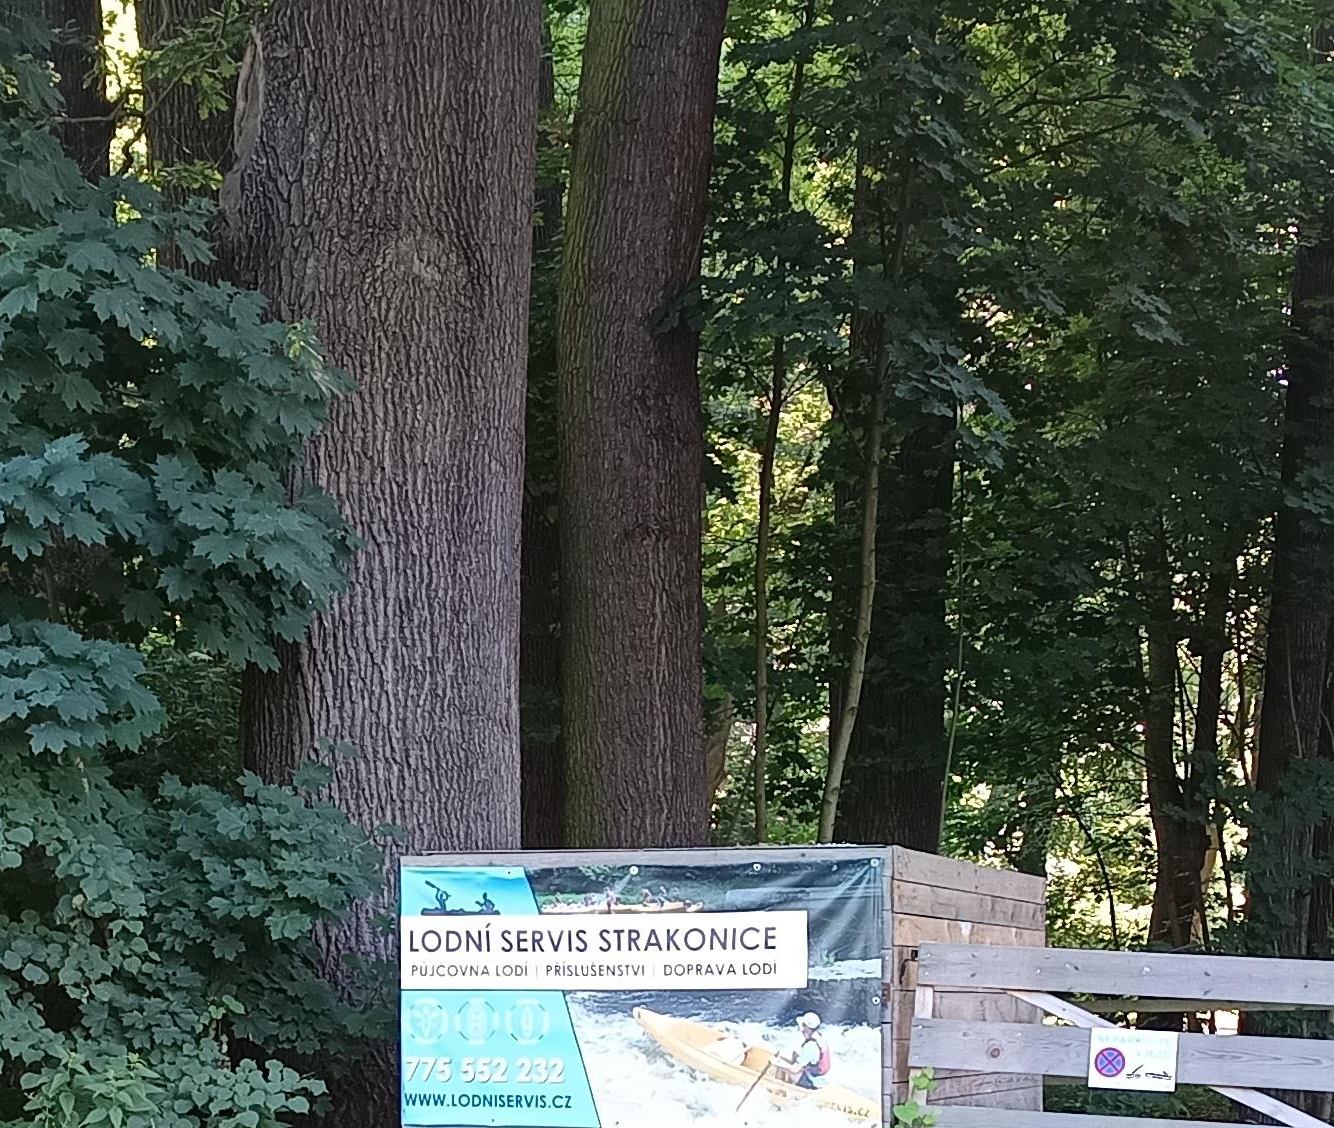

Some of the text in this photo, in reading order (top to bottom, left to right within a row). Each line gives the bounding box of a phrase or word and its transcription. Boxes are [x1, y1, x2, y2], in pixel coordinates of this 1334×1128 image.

[409, 922, 777, 953] LODNÍ SERVIS STRAKONICE
[495, 961, 529, 977] LODÍ
[663, 963, 737, 977] DOPRAVA
[742, 960, 777, 976] LODÍ
[405, 1056, 565, 1084] 775 552 232
[404, 1093, 573, 1109] WWW.LODNISERVIS.CZ
